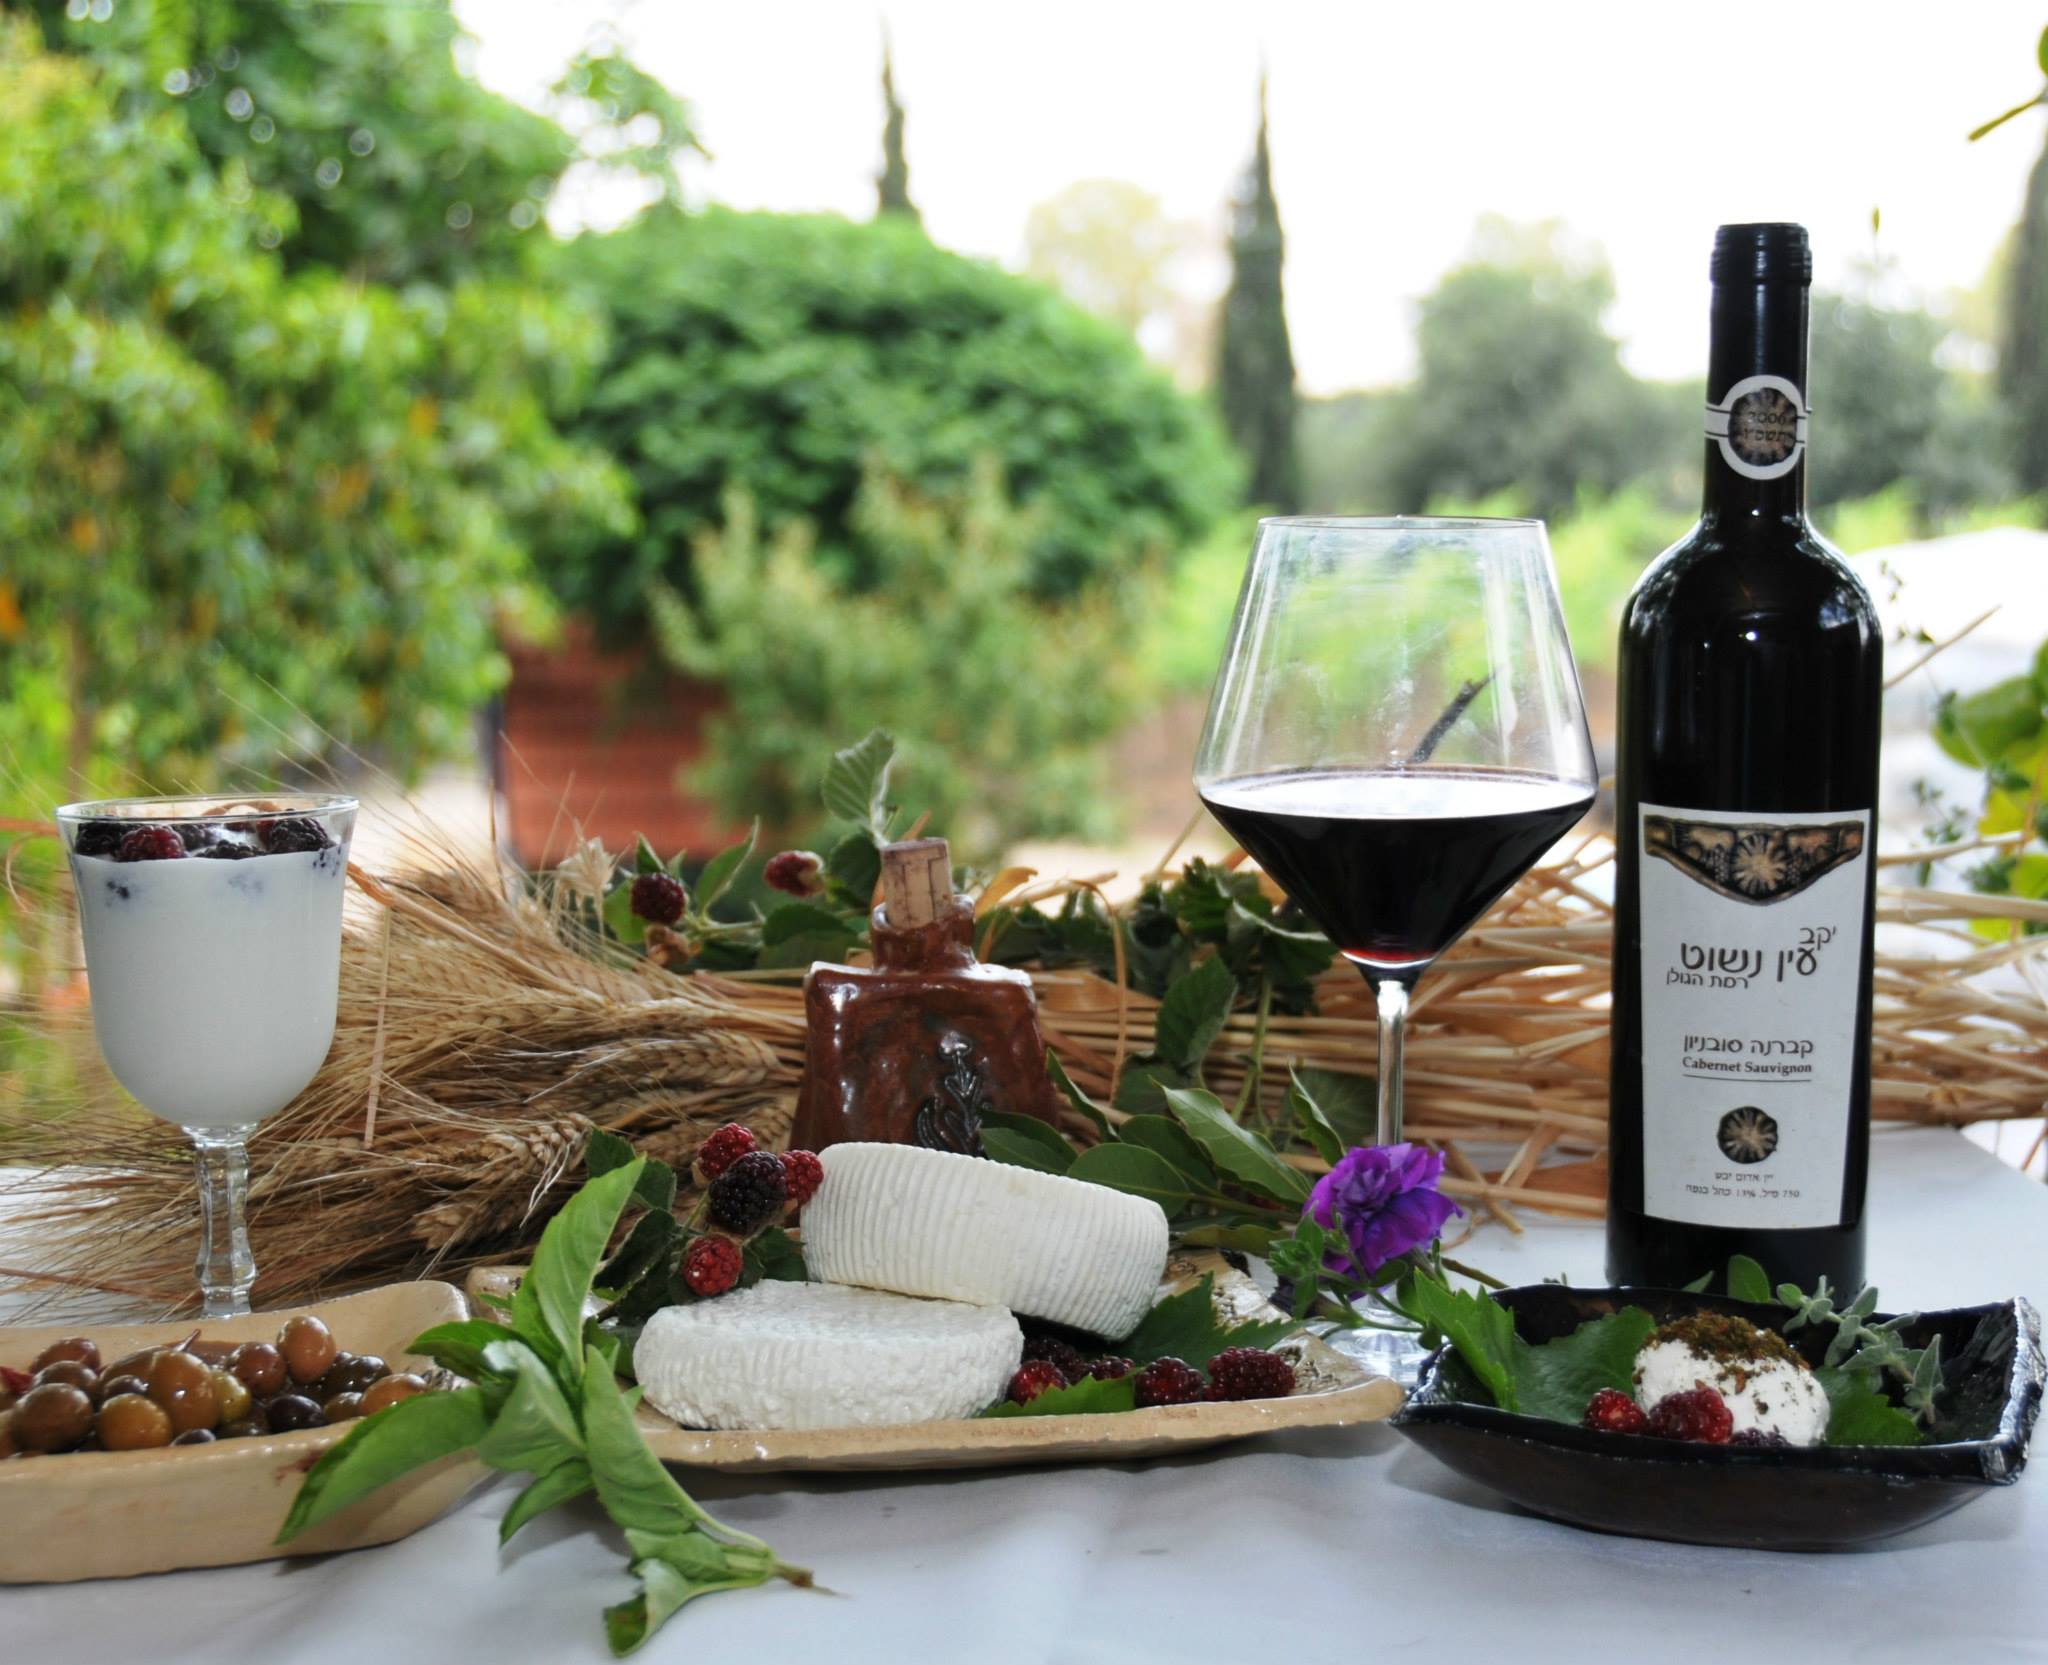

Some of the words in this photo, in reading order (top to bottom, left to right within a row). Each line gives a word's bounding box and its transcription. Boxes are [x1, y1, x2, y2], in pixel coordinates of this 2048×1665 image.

[1799, 926, 1837, 951] יקב
[1681, 942, 1762, 978] נשוט
[1777, 947, 1818, 983] עין
[1666, 967, 1704, 986] הגולן
[1750, 1040, 1814, 1059] קברנה
[1682, 1056, 1741, 1073] Cabernet
[1744, 1061, 1812, 1077] Sauvignon
[1735, 1173, 1761, 1182] אדום
